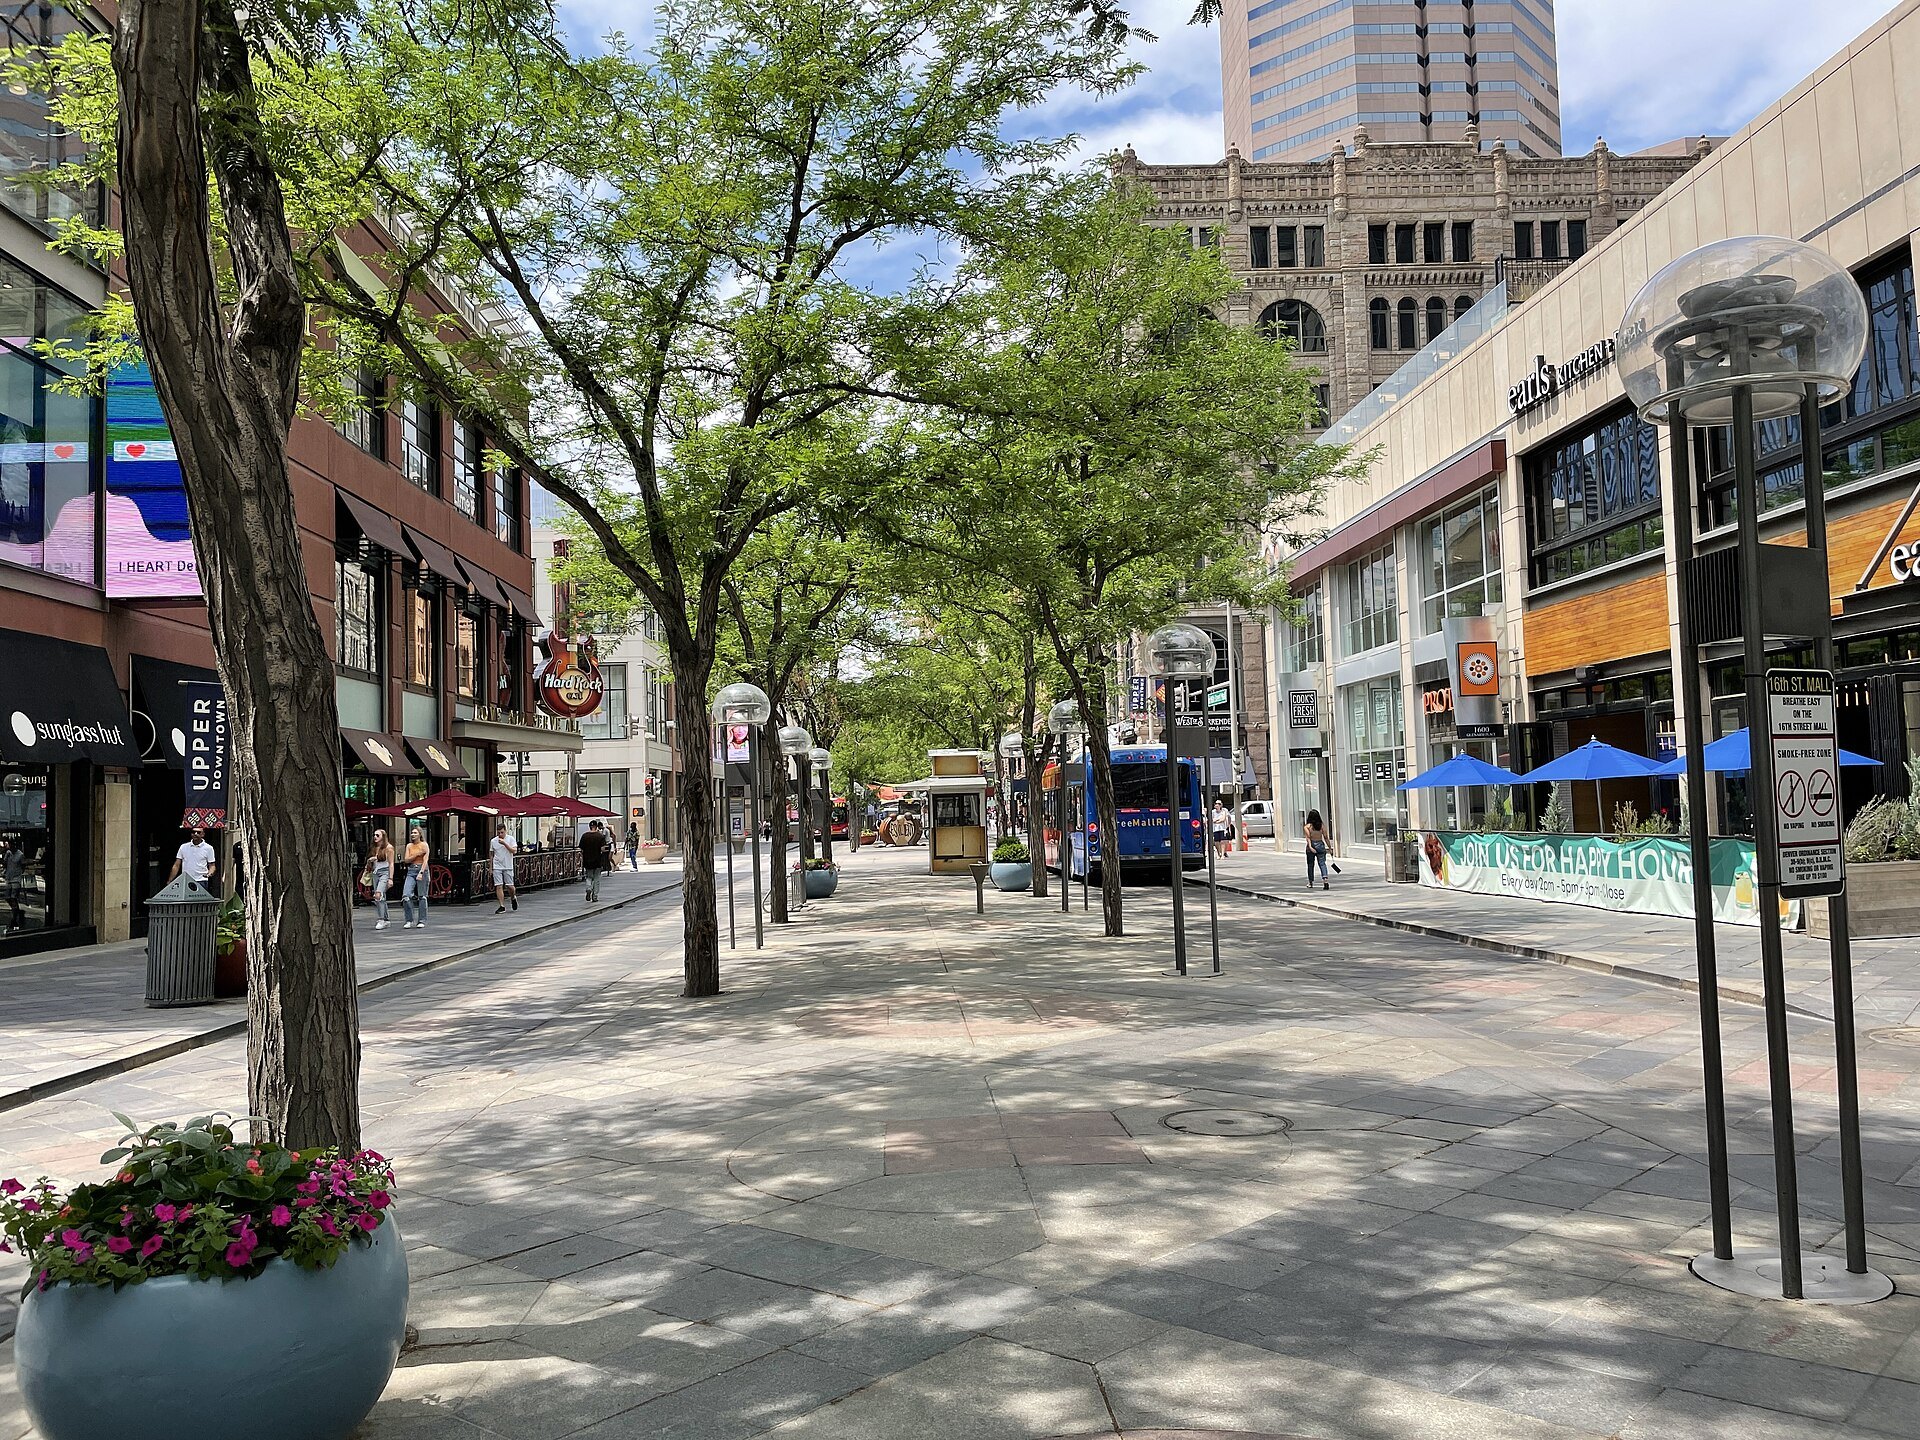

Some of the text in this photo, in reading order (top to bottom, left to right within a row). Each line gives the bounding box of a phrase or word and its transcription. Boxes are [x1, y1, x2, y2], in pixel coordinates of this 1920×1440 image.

[1507, 354, 1551, 414] earls
[1557, 342, 1604, 389] KITCHEN
[1604, 340, 1615, 354] +
[119, 560, 197, 573] I HEART De
[544, 673, 603, 694] Hard Rock
[1768, 676, 1832, 693] 16th ST. MALL
[1132, 677, 1140, 710] UPPER
[1292, 693, 1315, 704] COOK'S
[1782, 697, 1821, 706] BREATHE EASY
[1292, 705, 1315, 716] FRESH
[1792, 709, 1812, 719] ON THE
[1293, 717, 1315, 725] MARKET
[1778, 722, 1828, 731] 16TH STREET MALL
[36, 718, 125, 748] sunglass hut
[191, 699, 211, 791] UPPER
[212, 699, 226, 790] DOWNTOWN
[1777, 748, 1832, 759] SMOKE-FREE ZONE
[21, 775, 47, 787] sung
[1783, 822, 1790, 830] NO
[1817, 820, 1835, 828] SMOKING
[1460, 841, 1694, 884] JOIN US FOR HAPPY HOUR
[1501, 873, 1524, 891] Every
[1524, 875, 1538, 893] day
[1539, 876, 1555, 892] 2pm
[1561, 879, 1579, 897] 5pm
